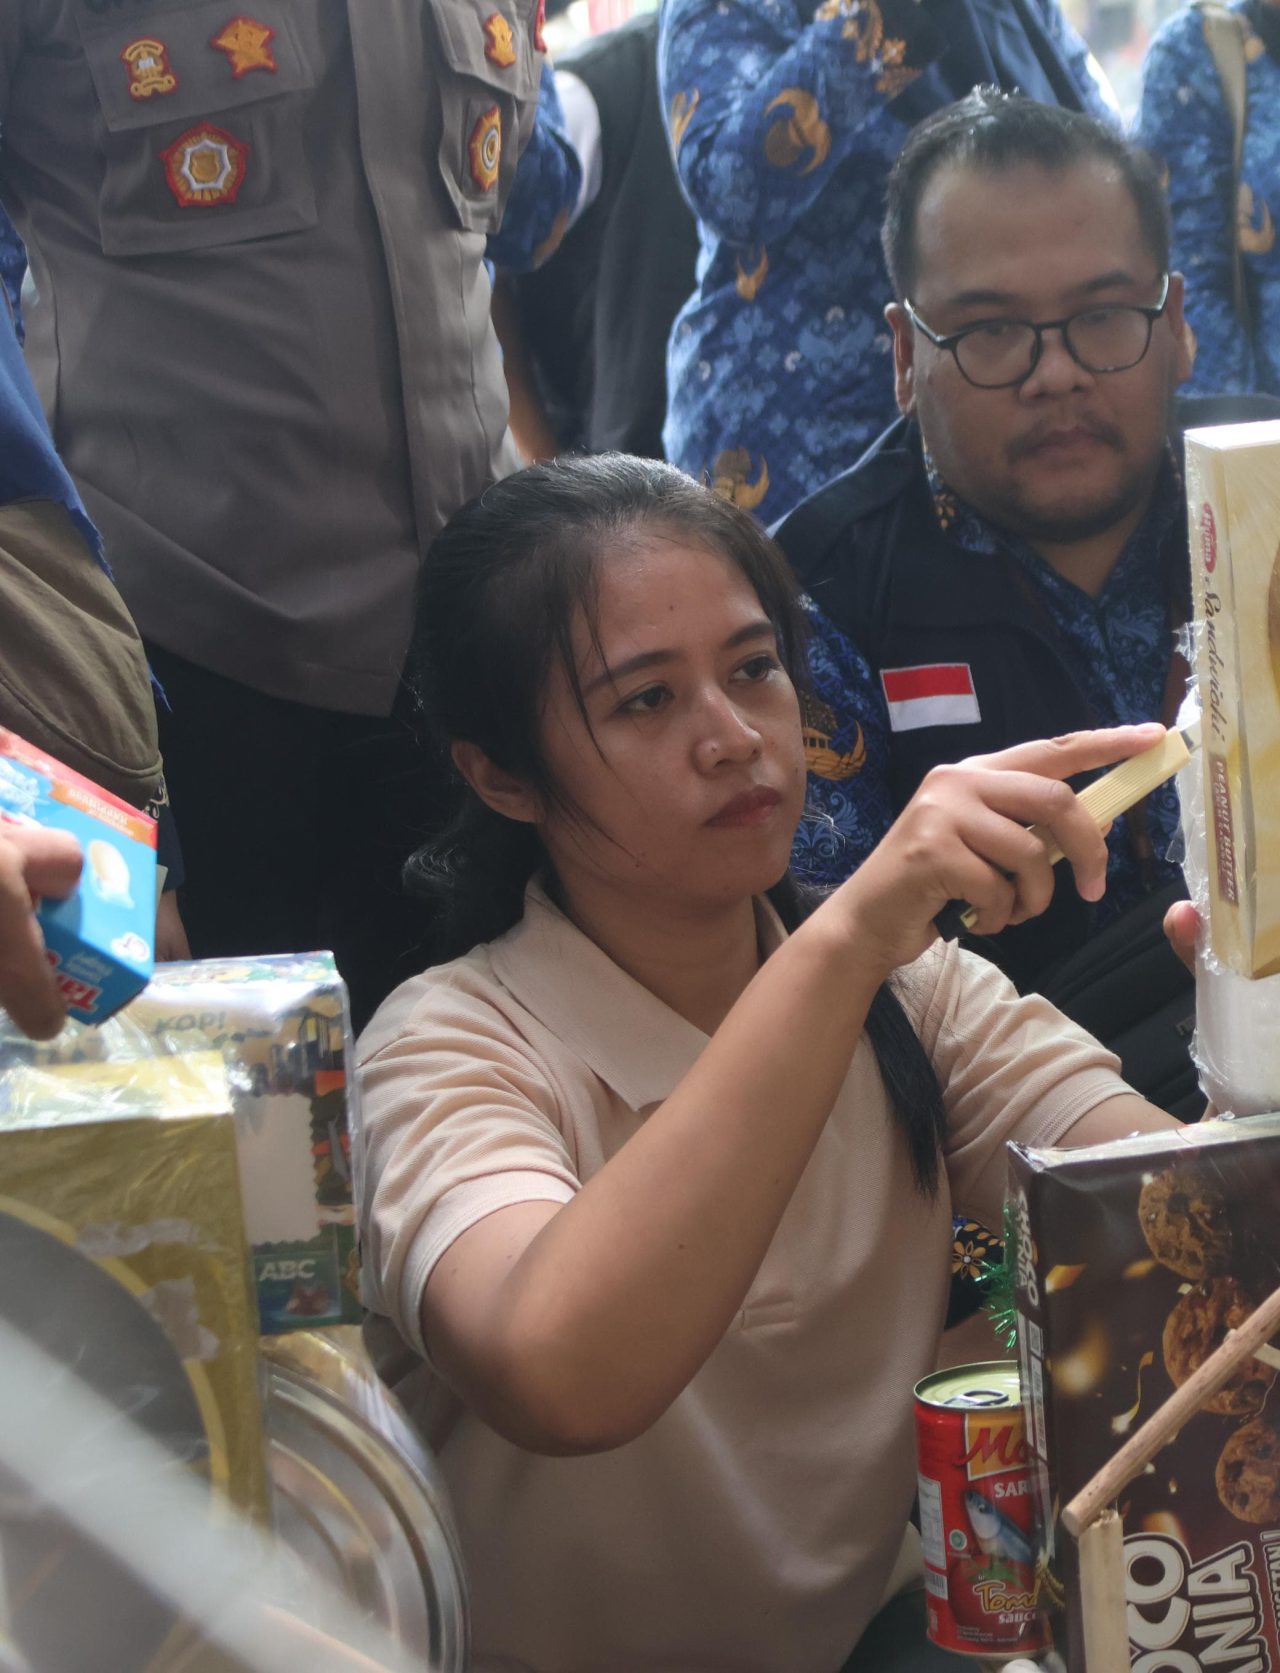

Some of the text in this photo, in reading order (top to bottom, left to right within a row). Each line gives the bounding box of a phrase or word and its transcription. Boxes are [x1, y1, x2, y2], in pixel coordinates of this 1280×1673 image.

[1205, 577, 1228, 742] Sandwichi
[1216, 761, 1236, 901] PEANUT BUTTER
[259, 1258, 316, 1282] ABC
[993, 1480, 1028, 1499] SAR
